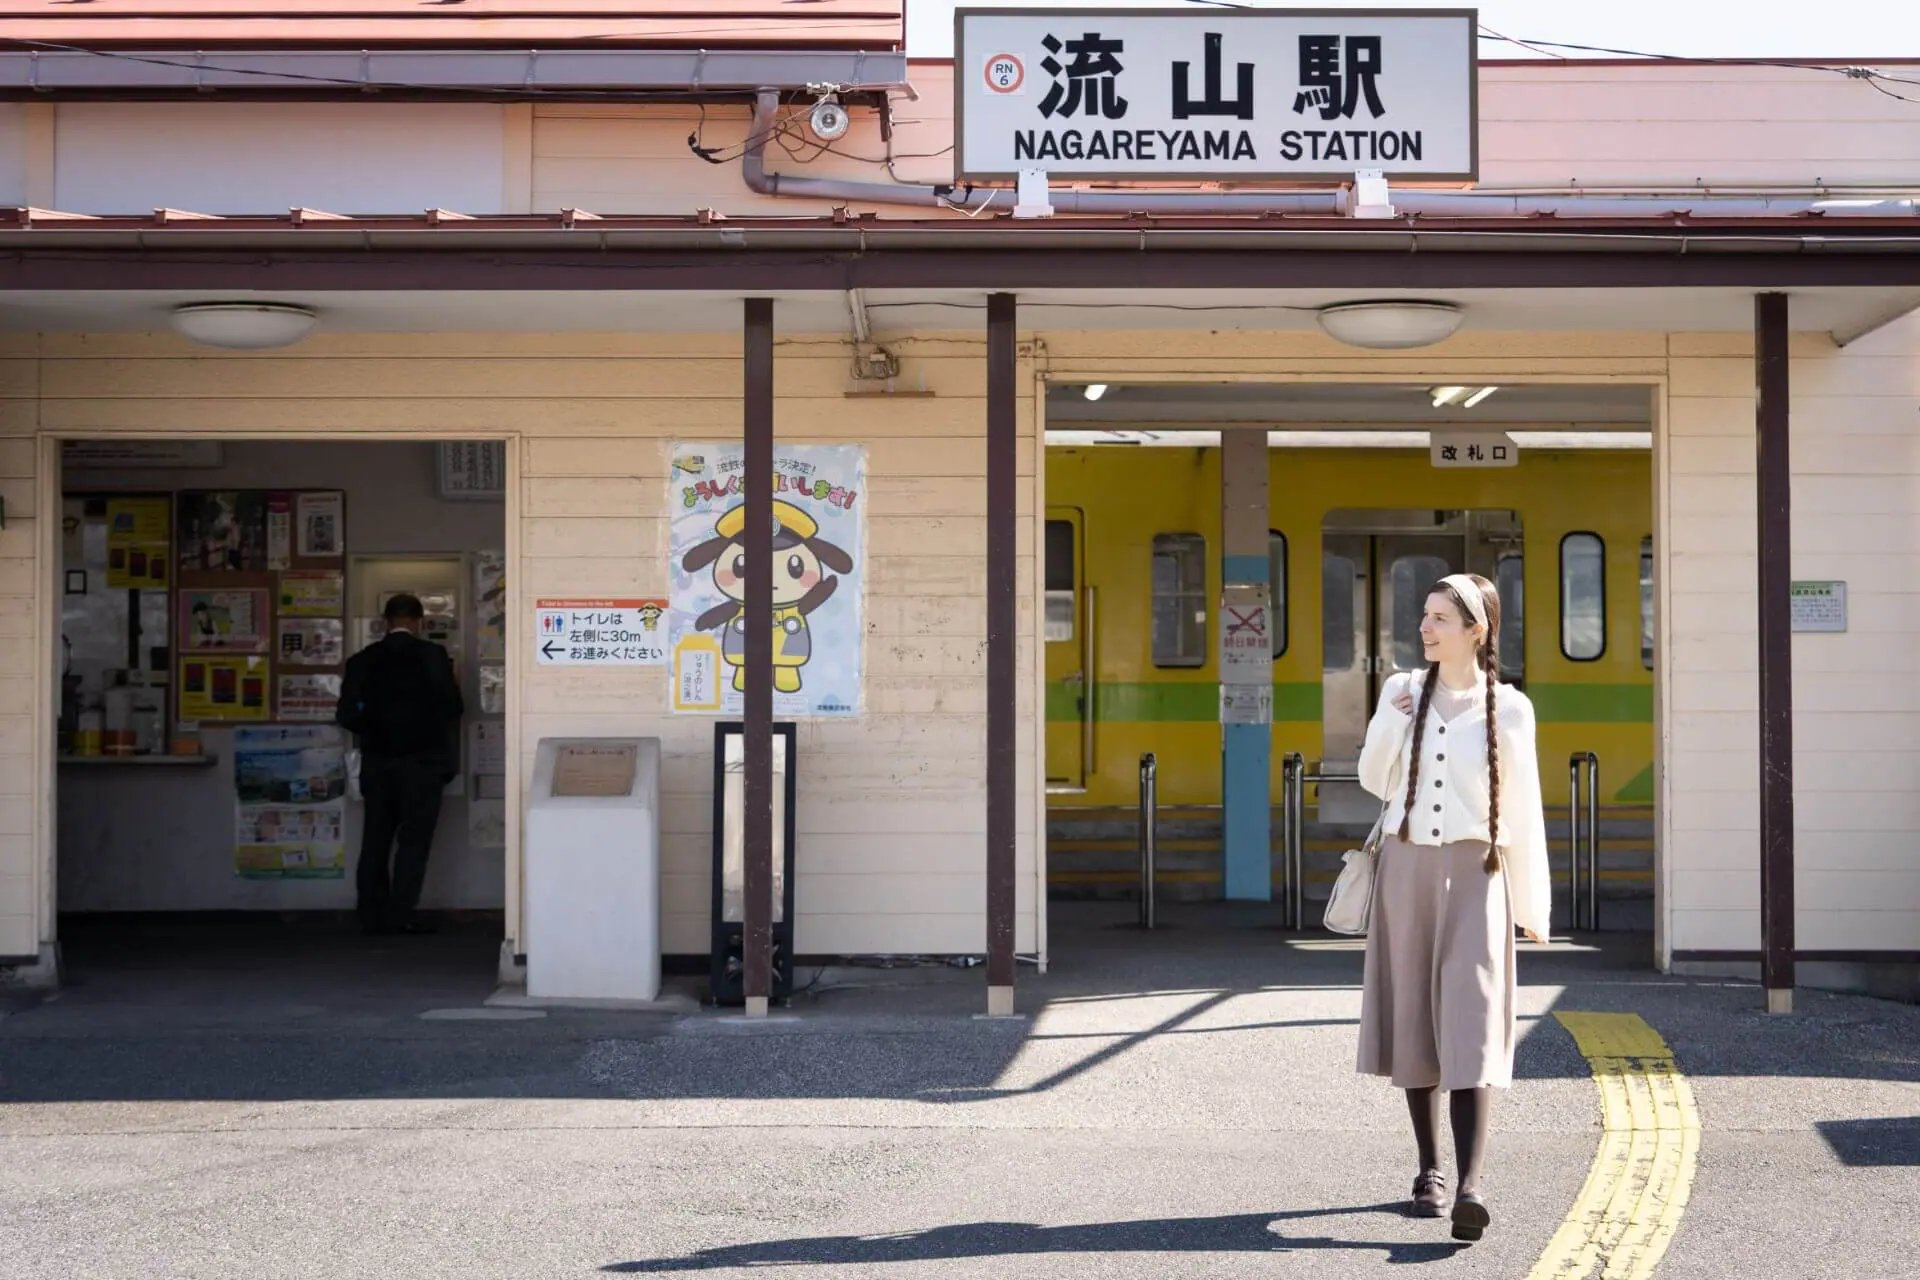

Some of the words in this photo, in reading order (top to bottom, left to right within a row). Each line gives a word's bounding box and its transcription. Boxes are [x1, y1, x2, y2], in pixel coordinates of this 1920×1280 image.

[995, 64, 1013, 74] RN
[999, 74, 1009, 86] 6
[1037, 32, 1386, 120] 流山駅
[1014, 129, 1257, 161] NAGAREYAMA
[1279, 130, 1422, 161] STATION
[1440, 444, 1507, 461] 改札口
[571, 612, 624, 625] トイレは
[570, 630, 641, 643] 左側に30m
[570, 647, 663, 660] お進みください
